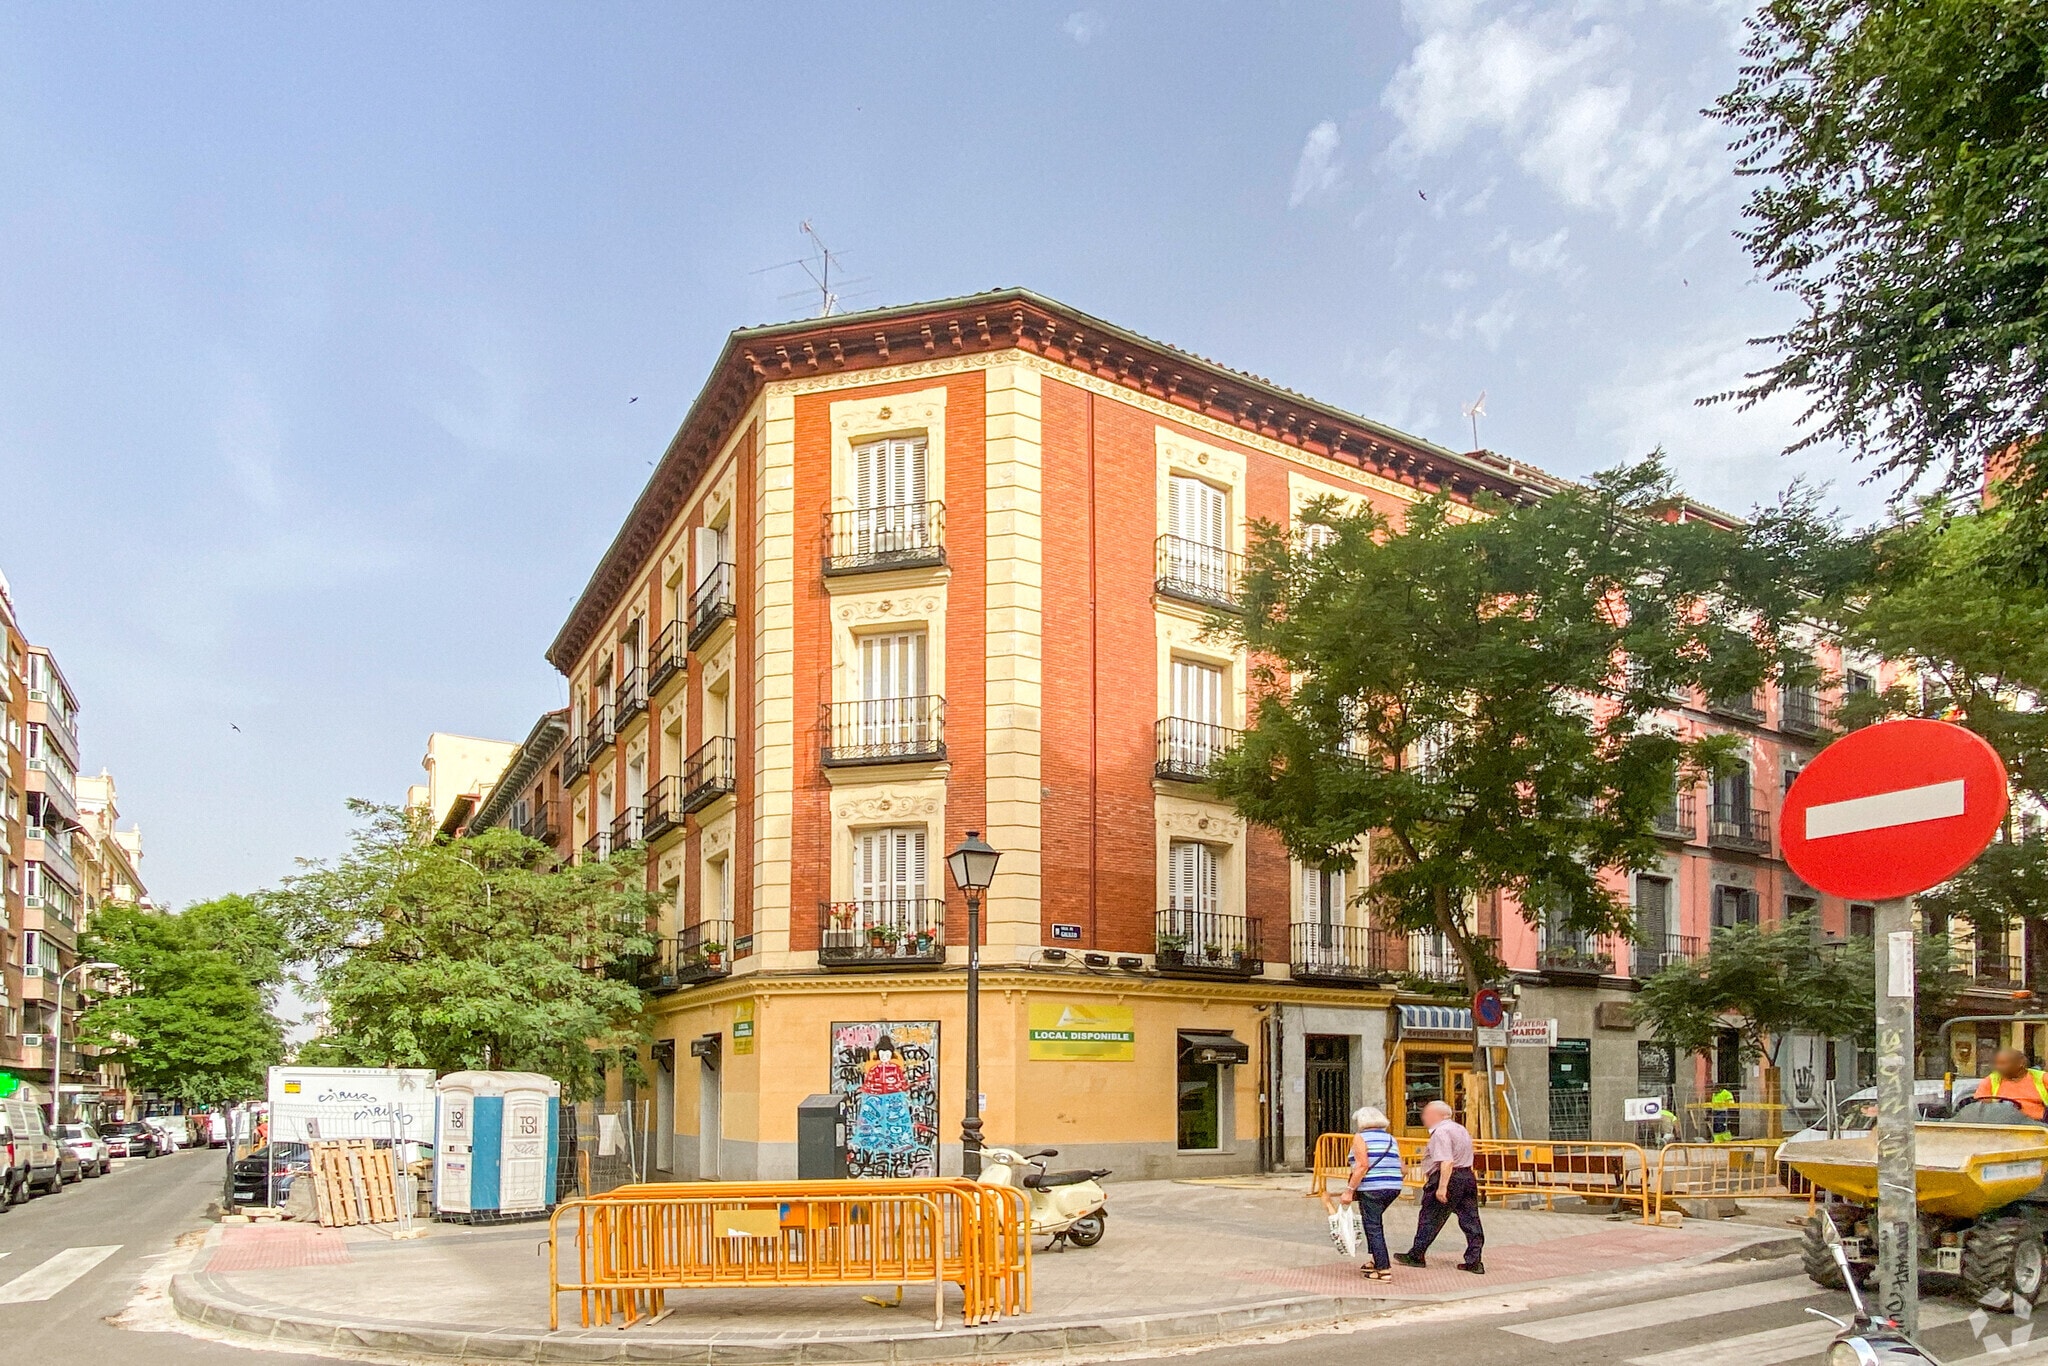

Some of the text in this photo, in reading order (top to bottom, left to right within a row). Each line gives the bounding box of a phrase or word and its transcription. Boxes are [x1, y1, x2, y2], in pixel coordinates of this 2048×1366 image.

[1034, 1031, 1130, 1041] LOCAL DISPONIBLE
[1512, 1028, 1546, 1036] MARTOS
[451, 1119, 464, 1129] TOI
[520, 1116, 538, 1125] TOI
[520, 1125, 538, 1134] TOI
